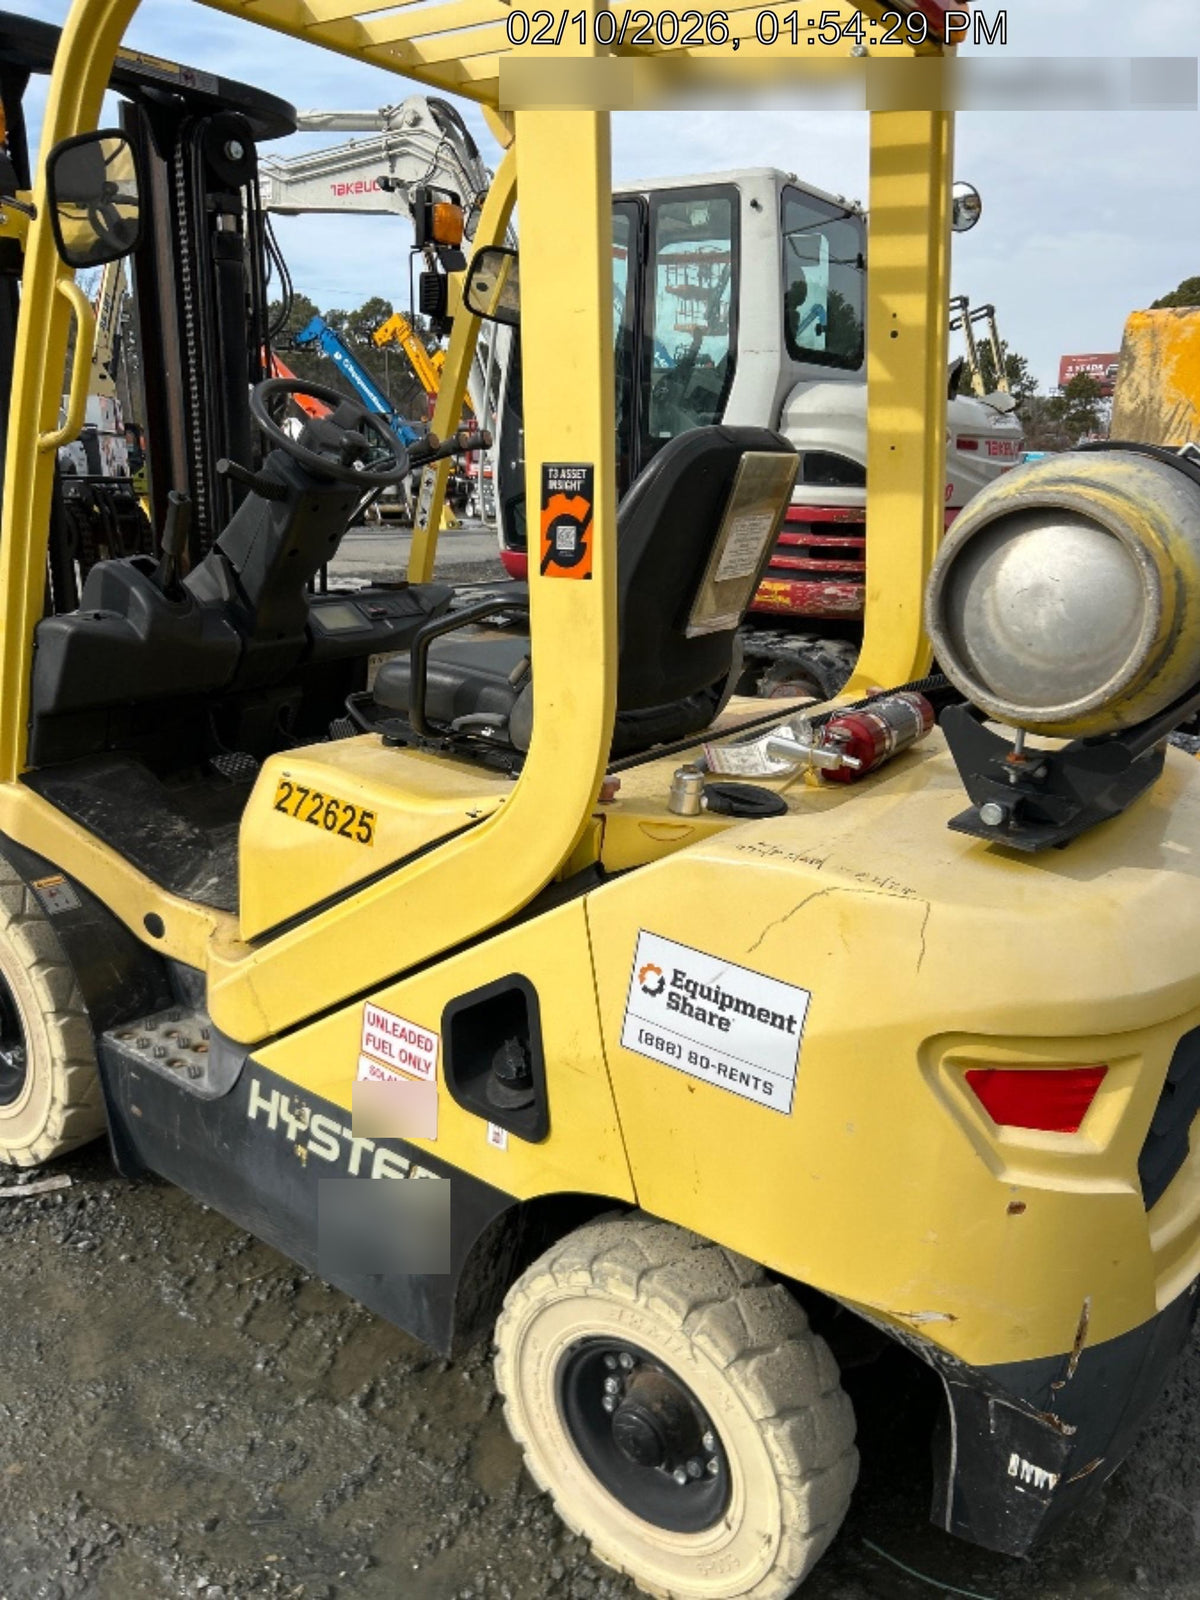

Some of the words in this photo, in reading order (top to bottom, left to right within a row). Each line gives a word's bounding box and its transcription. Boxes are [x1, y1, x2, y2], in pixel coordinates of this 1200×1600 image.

[330, 180, 381, 196] TAKEUC
[548, 468, 559, 479] T3
[560, 468, 587, 479] ASSET
[548, 479, 582, 491] INSIGHT
[274, 782, 374, 844] 272625
[666, 991, 732, 1034] Share
[670, 968, 798, 1035] Equipment
[365, 1032, 395, 1058] FUEL
[398, 1048, 433, 1074] ONLY
[367, 1011, 434, 1053] UNLEADED
[637, 1028, 683, 1059] (888)
[687, 1050, 774, 1096] 80-RENTS
